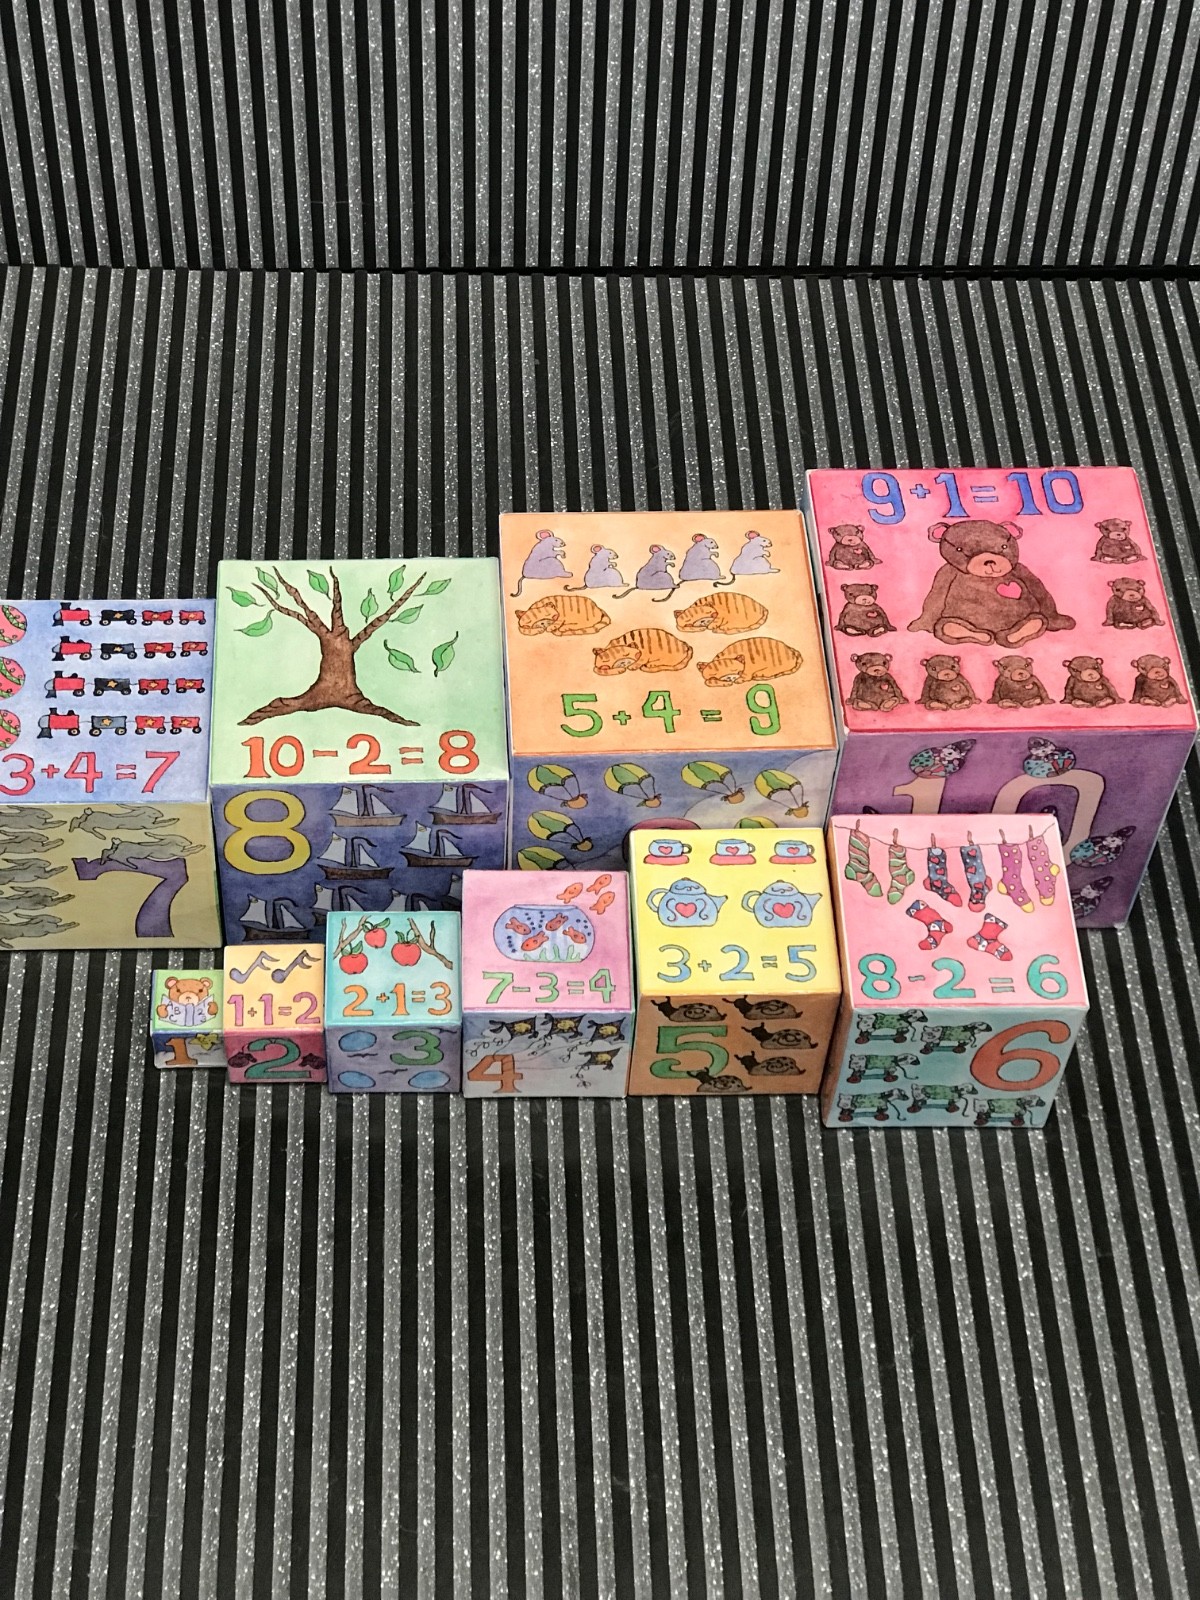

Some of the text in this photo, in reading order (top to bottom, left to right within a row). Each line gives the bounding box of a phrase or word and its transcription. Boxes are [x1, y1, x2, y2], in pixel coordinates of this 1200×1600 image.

[223, 789, 311, 875] 8
[71, 857, 189, 938] 7
[165, 1037, 198, 1065] 1
[245, 1037, 312, 1079] 2
[390, 1030, 444, 1066] 3
[650, 1025, 730, 1080] 5
[970, 1019, 1071, 1092] 6
[467, 1053, 523, 1094] 4
